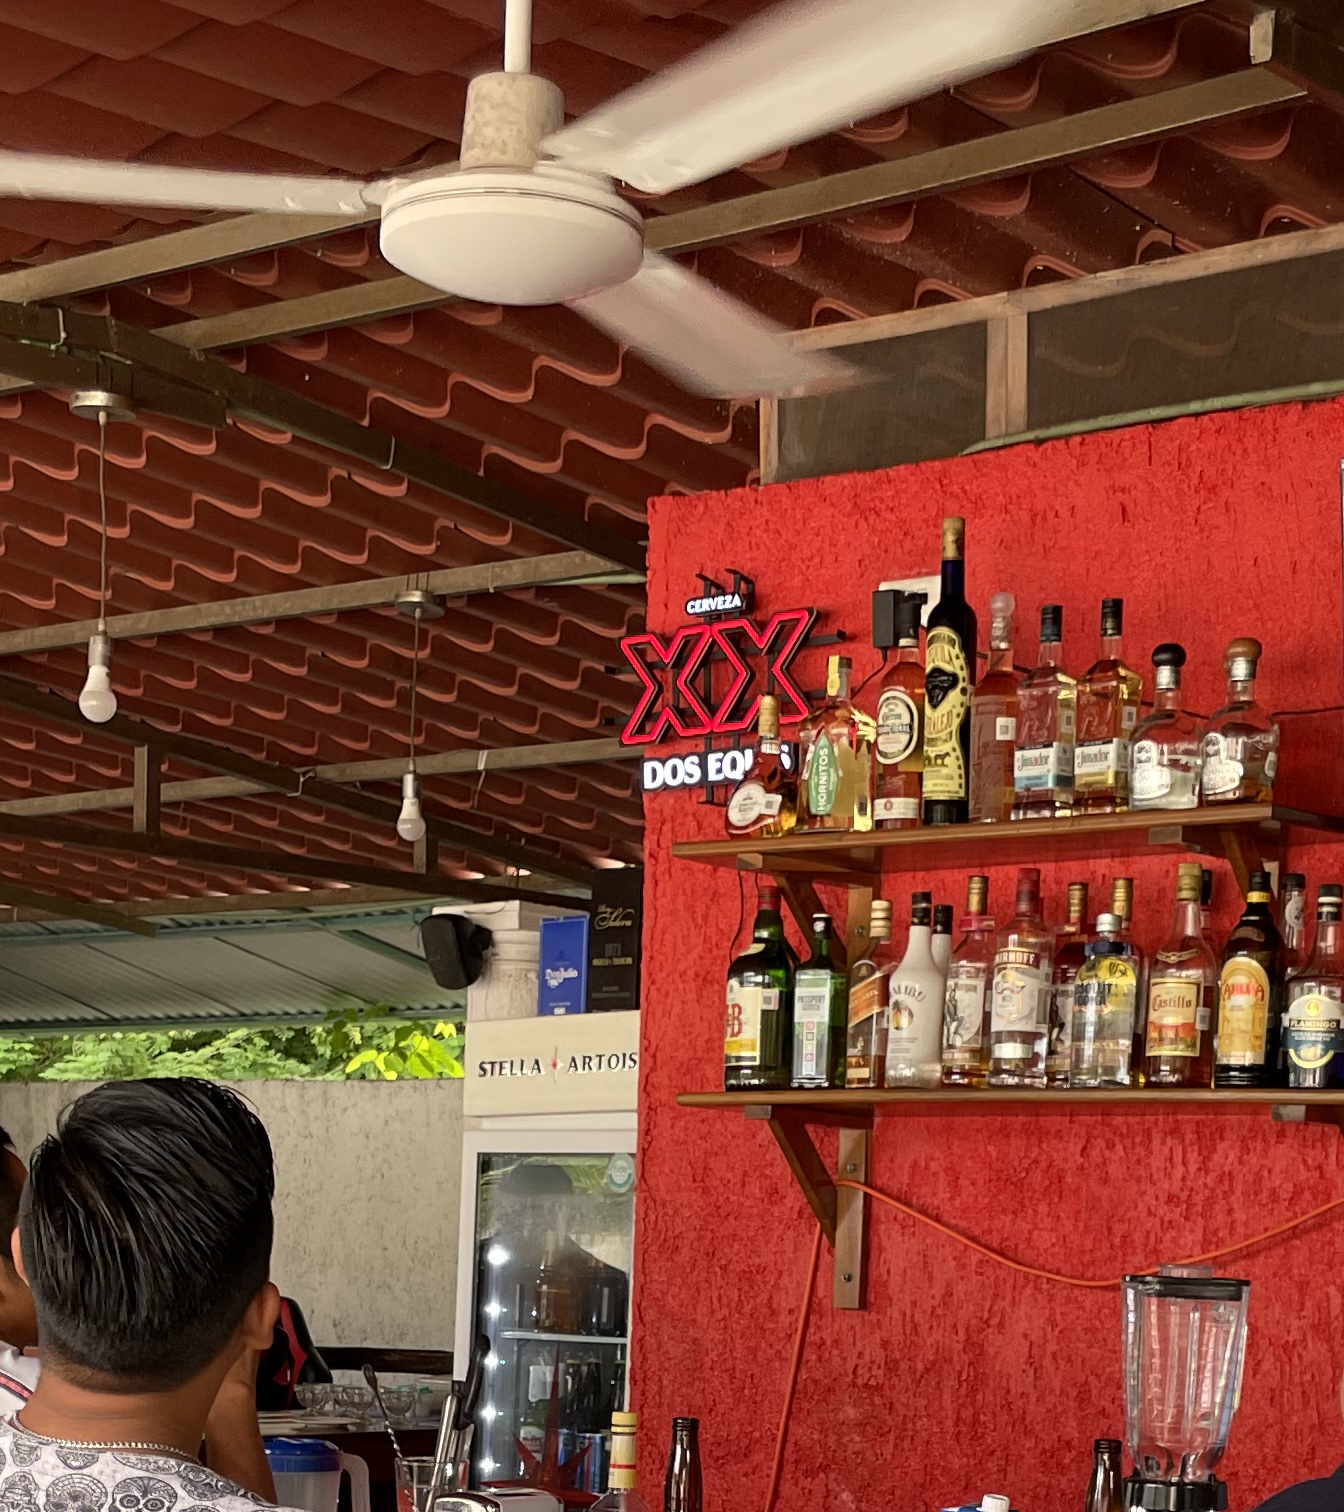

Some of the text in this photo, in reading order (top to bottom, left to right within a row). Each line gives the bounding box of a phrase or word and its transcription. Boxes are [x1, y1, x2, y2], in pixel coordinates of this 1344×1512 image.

[686, 594, 741, 614] CERVEZA
[620, 608, 809, 746] XX
[643, 754, 702, 790] DOS
[816, 746, 830, 813] HORNITOS
[1152, 996, 1193, 1012] Castillo
[1290, 1020, 1337, 1030] FLAMINGO
[478, 1051, 638, 1078] STELLA ARTOIS
